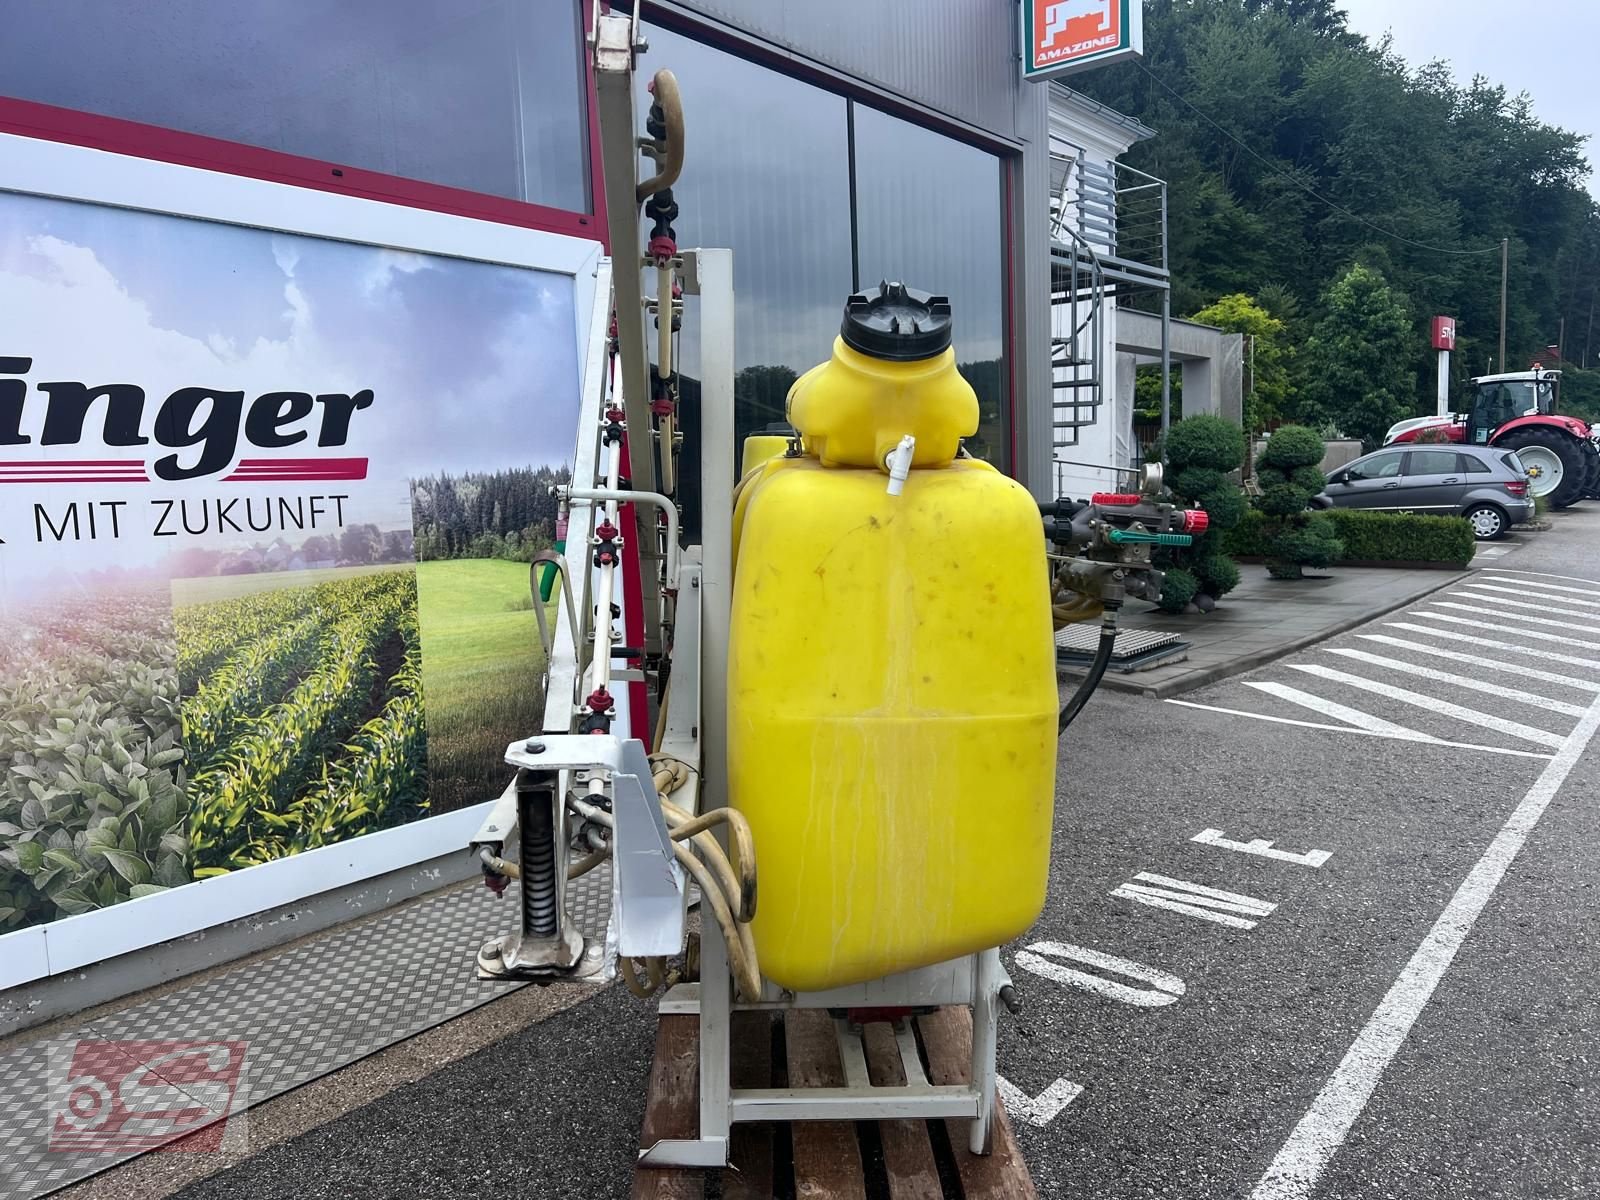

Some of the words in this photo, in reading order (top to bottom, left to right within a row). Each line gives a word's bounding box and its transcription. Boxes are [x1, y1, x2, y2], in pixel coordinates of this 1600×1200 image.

[1037, 34, 1116, 62] AMAZONE
[33, 502, 128, 542] MIT
[150, 495, 349, 537] ZUKUNFT
